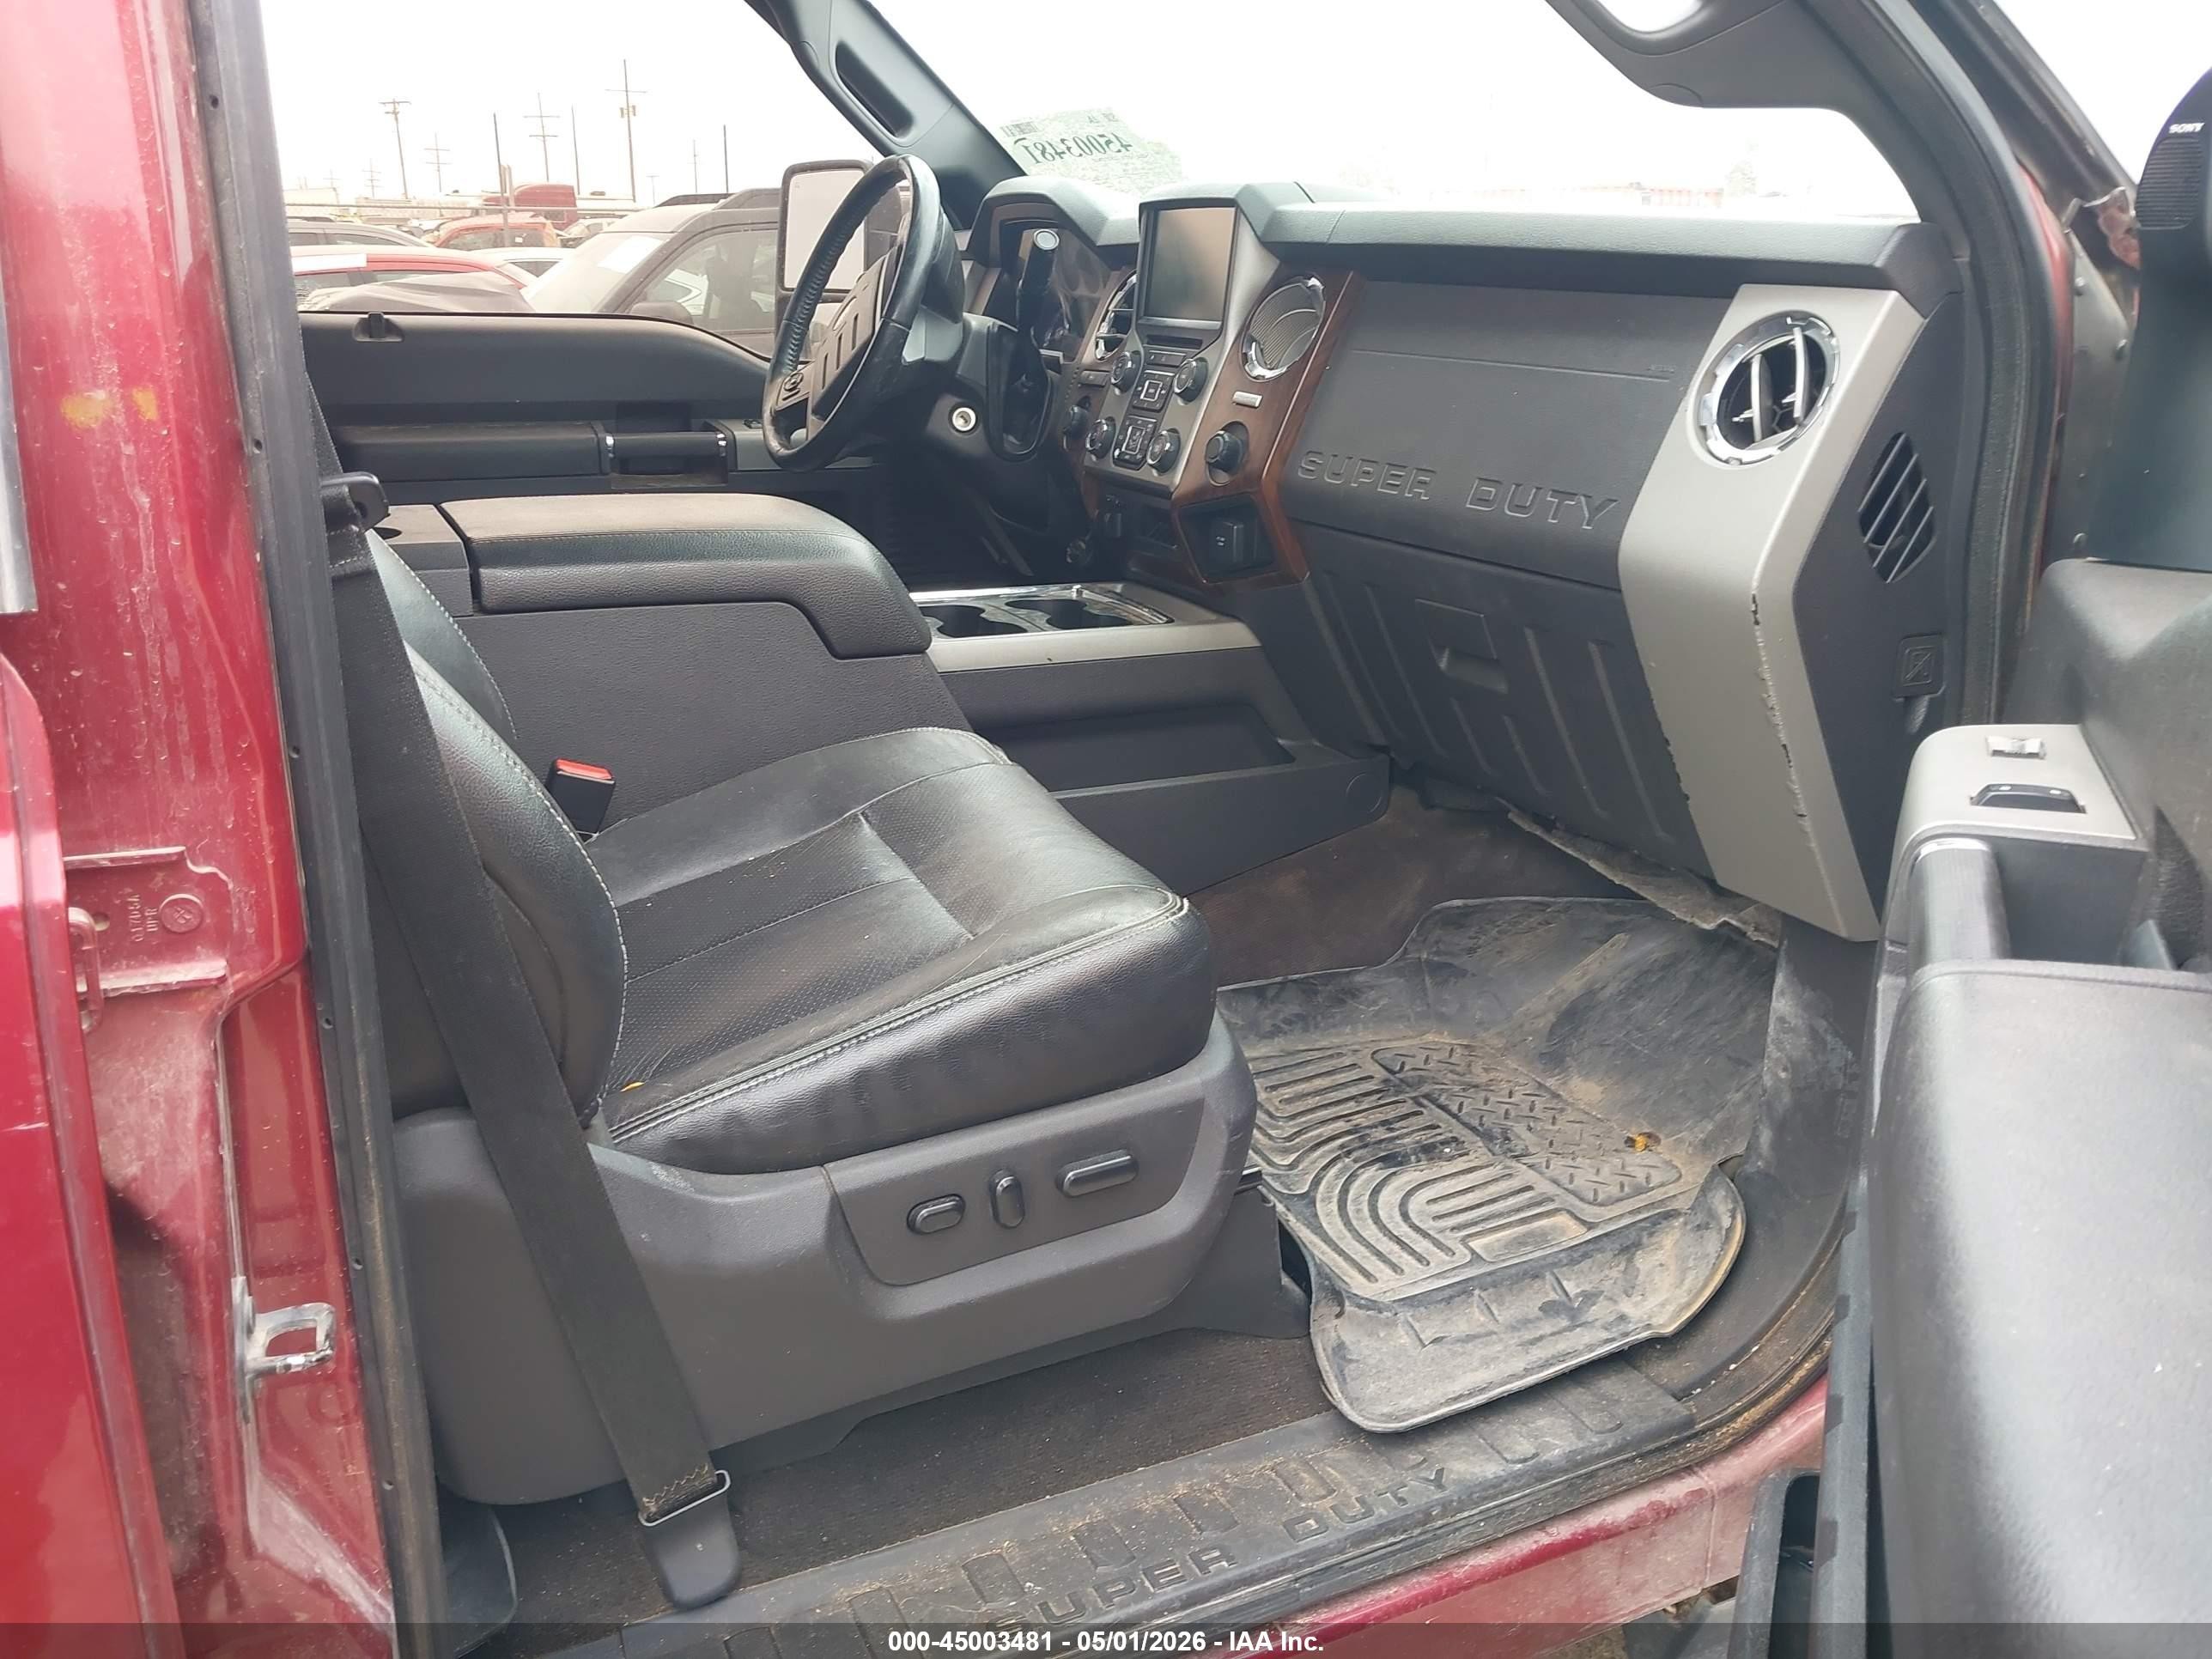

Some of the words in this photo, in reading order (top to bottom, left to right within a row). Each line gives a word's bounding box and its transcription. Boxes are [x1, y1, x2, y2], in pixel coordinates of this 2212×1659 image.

[2168, 122, 2205, 133] SONY
[1297, 450, 1437, 501] SUPER
[1465, 476, 1620, 530] DUTY
[987, 1544, 1237, 1638] SUPER
[1282, 1467, 1447, 1543] DUTY
